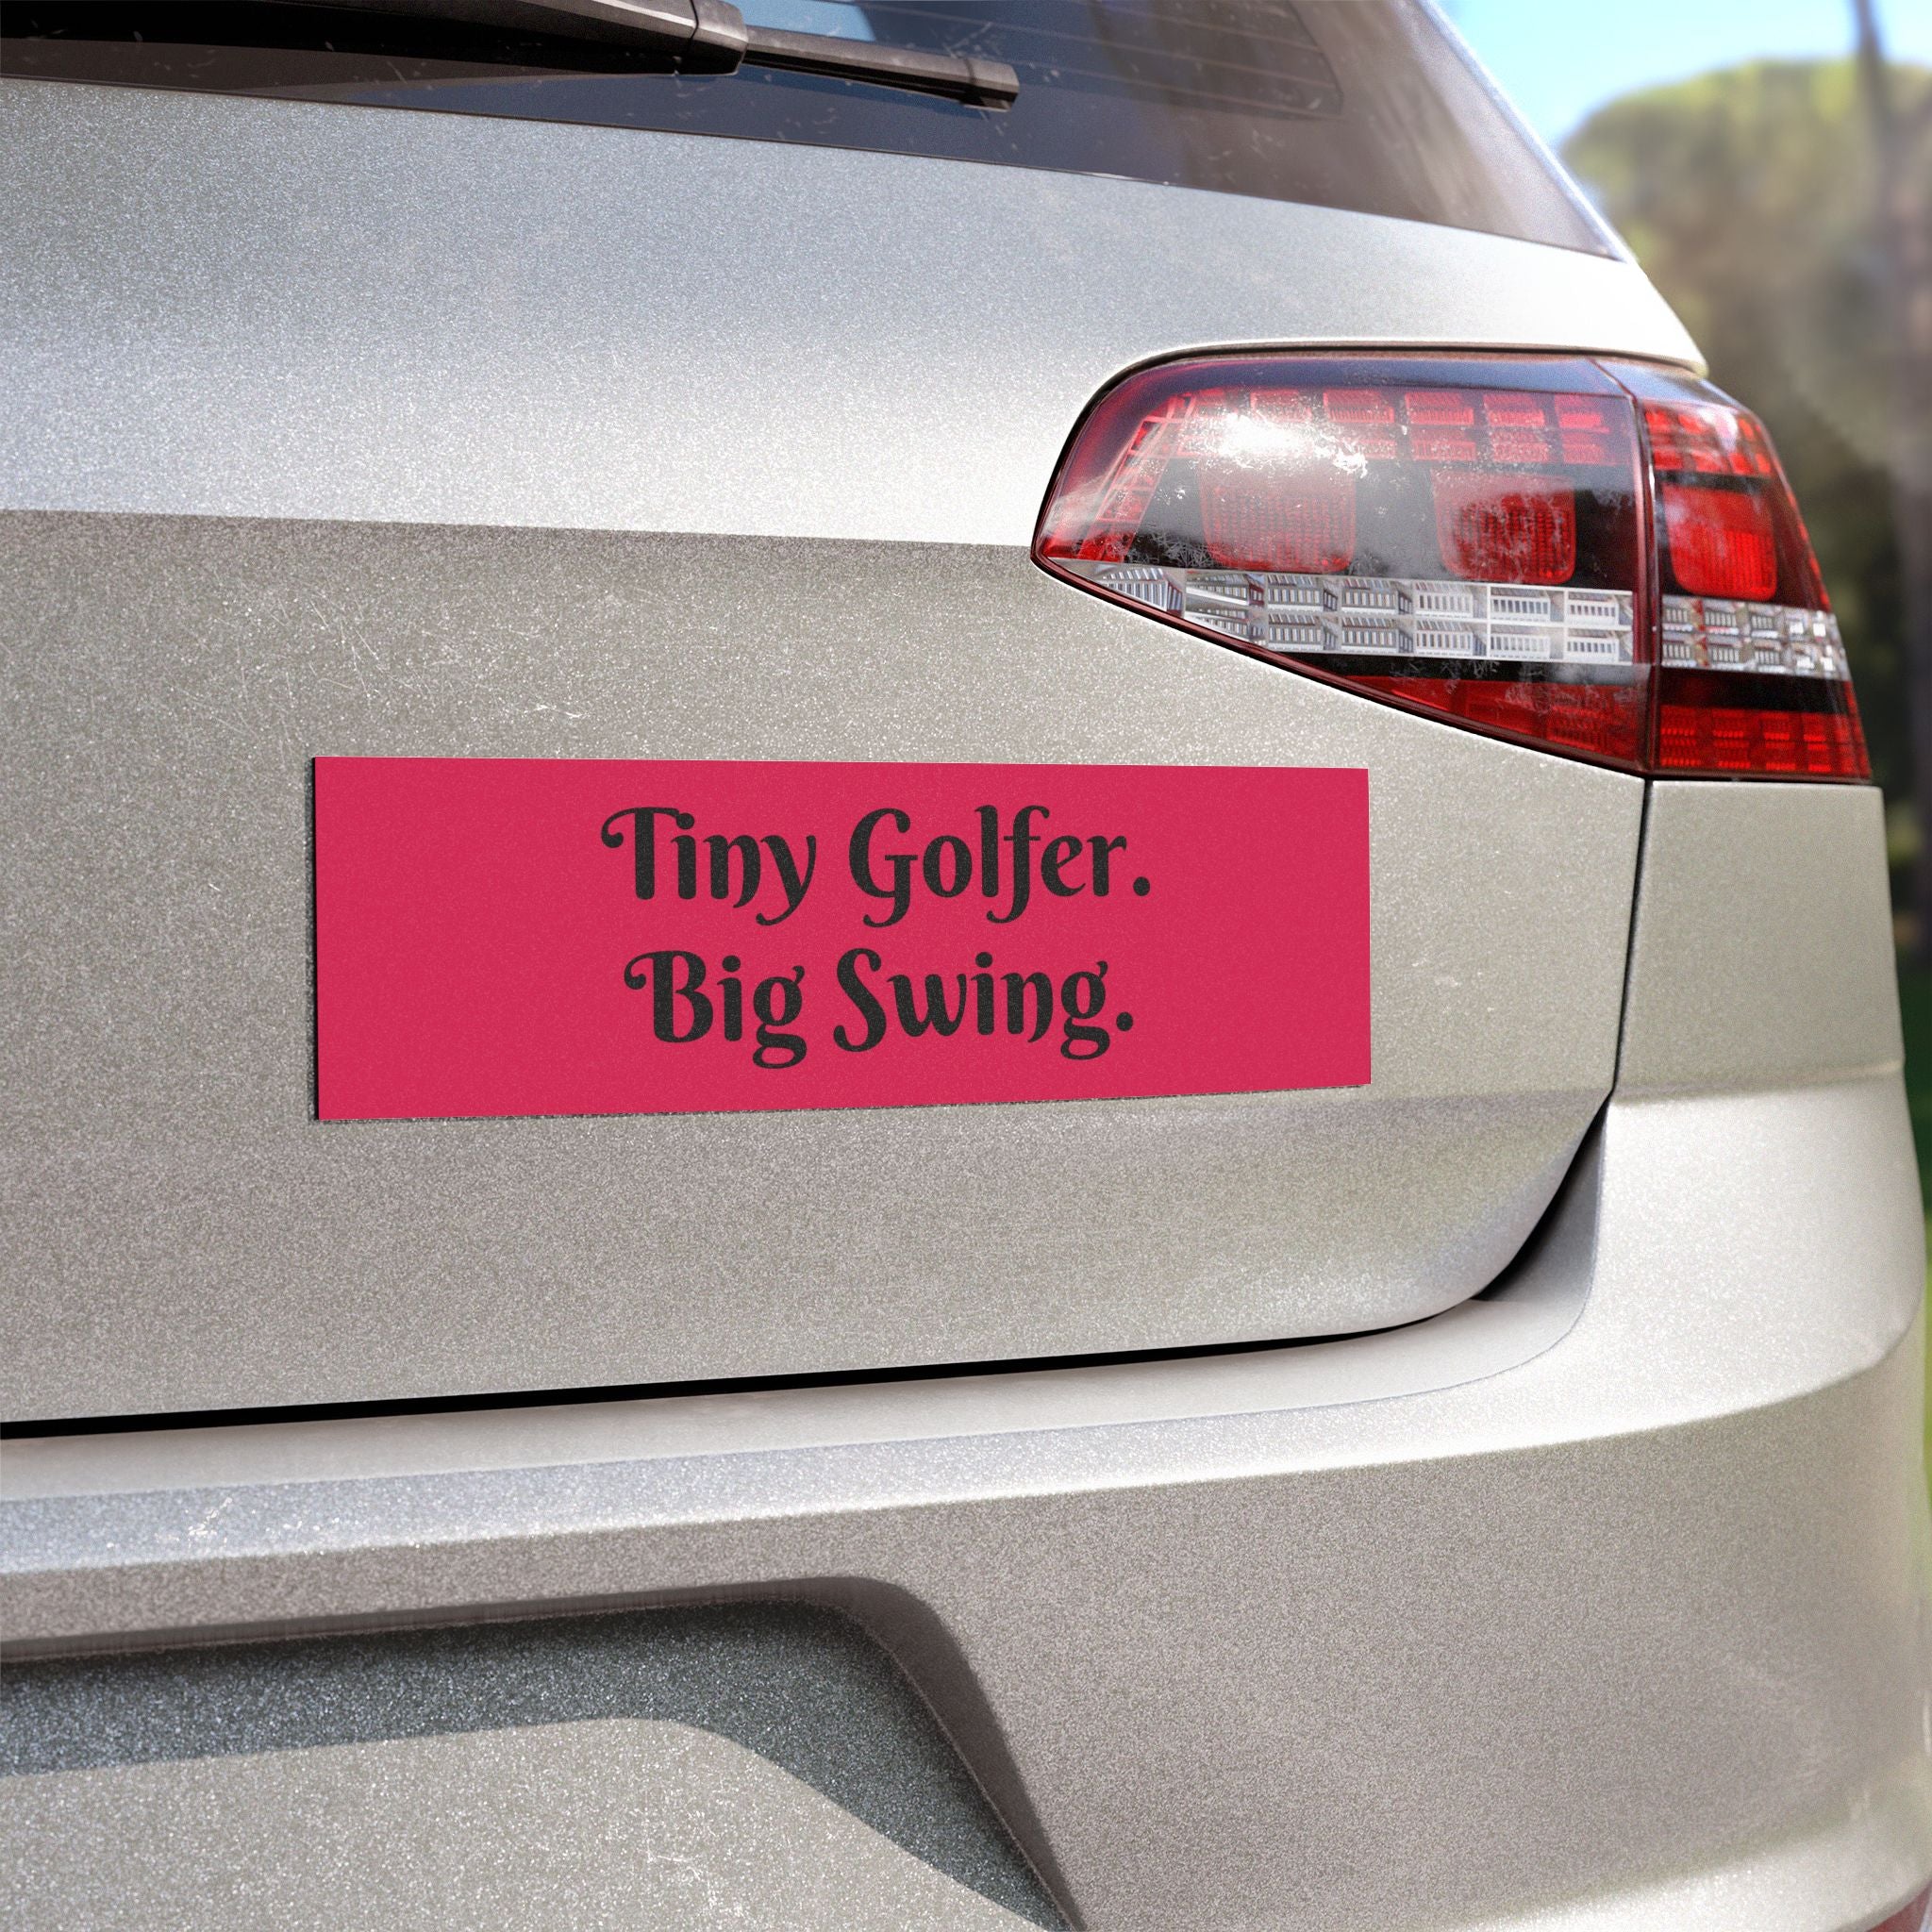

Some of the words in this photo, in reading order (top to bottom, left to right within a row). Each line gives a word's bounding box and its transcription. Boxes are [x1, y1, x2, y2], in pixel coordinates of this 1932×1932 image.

[600, 807, 817, 926] Tiny
[848, 805, 1151, 928] Golfer.
[624, 950, 808, 1070] Big
[833, 947, 1134, 1060] Swing.
